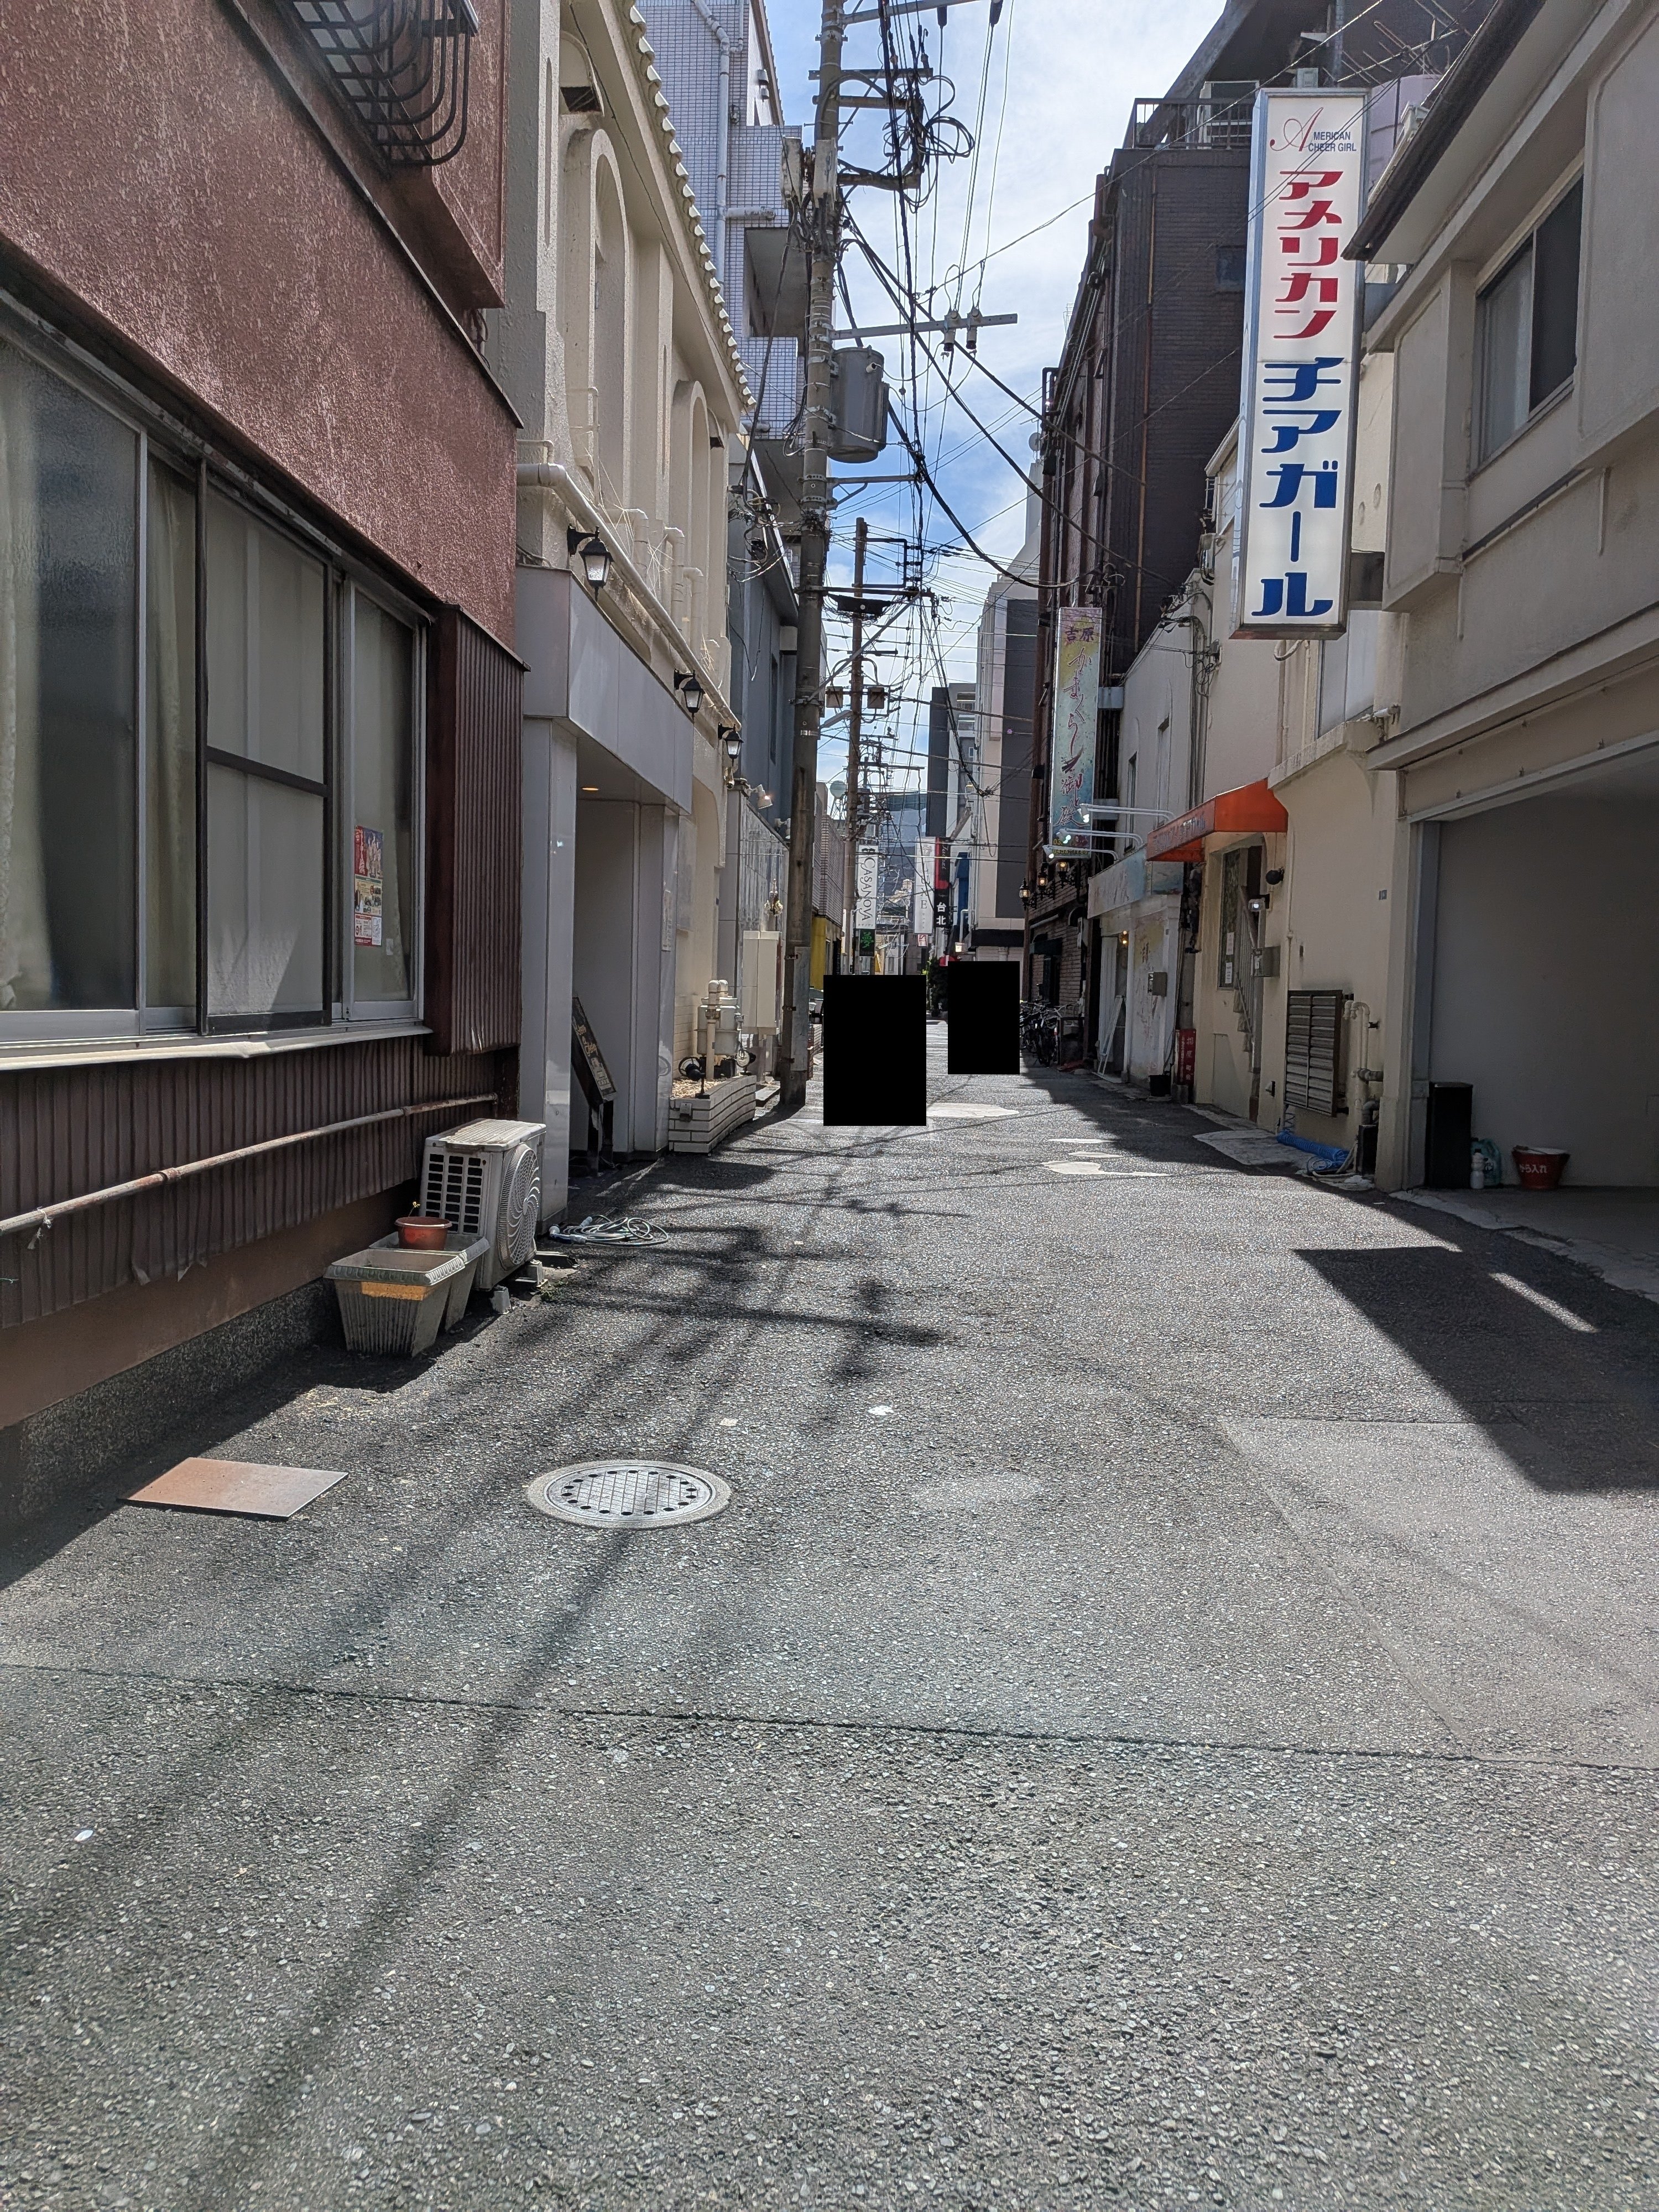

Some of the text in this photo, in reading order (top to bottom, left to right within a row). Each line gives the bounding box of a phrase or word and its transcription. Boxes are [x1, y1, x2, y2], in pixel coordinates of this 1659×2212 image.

[1308, 143, 1357, 152] CHEER GIRL
[1065, 626, 1094, 642] 吉原
[860, 857, 876, 921] CASANOVA
[936, 901, 947, 925] 台北
